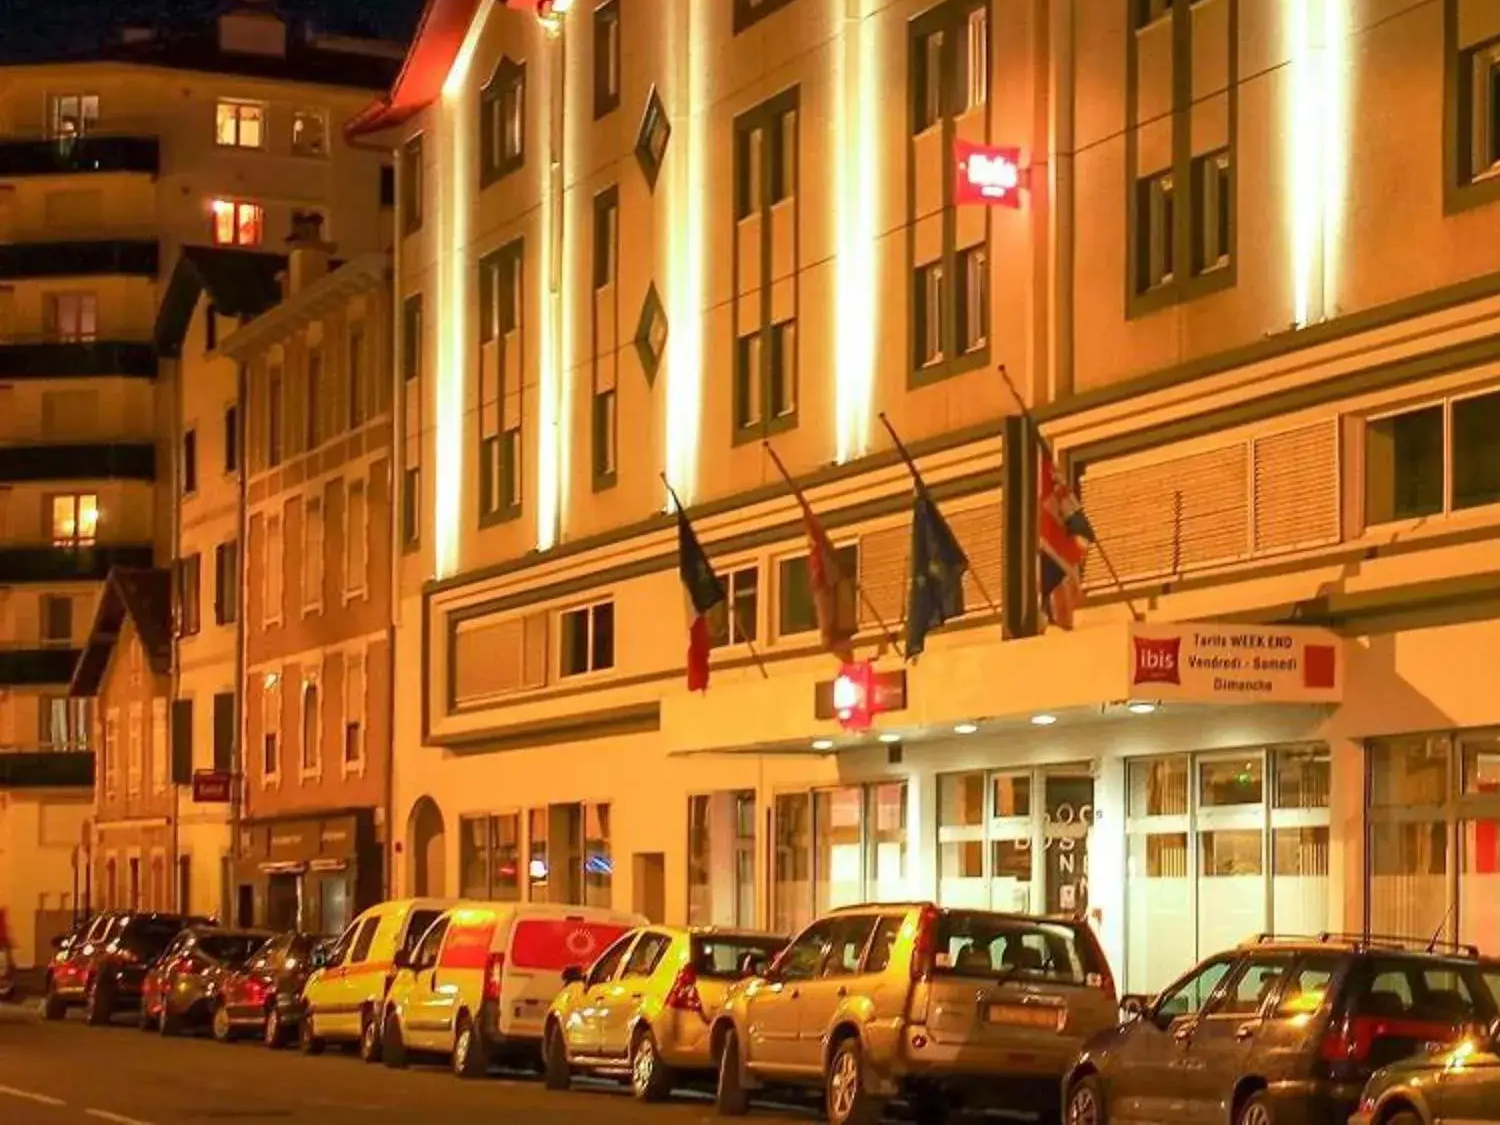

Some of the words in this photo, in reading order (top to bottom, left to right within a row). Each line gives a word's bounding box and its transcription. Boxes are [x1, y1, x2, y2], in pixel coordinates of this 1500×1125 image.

[1141, 648, 1174, 669] ibis
[1188, 654, 1242, 669] Vendredi
[1253, 655, 1298, 670] Samedi
[1213, 676, 1273, 692] Dimanche
